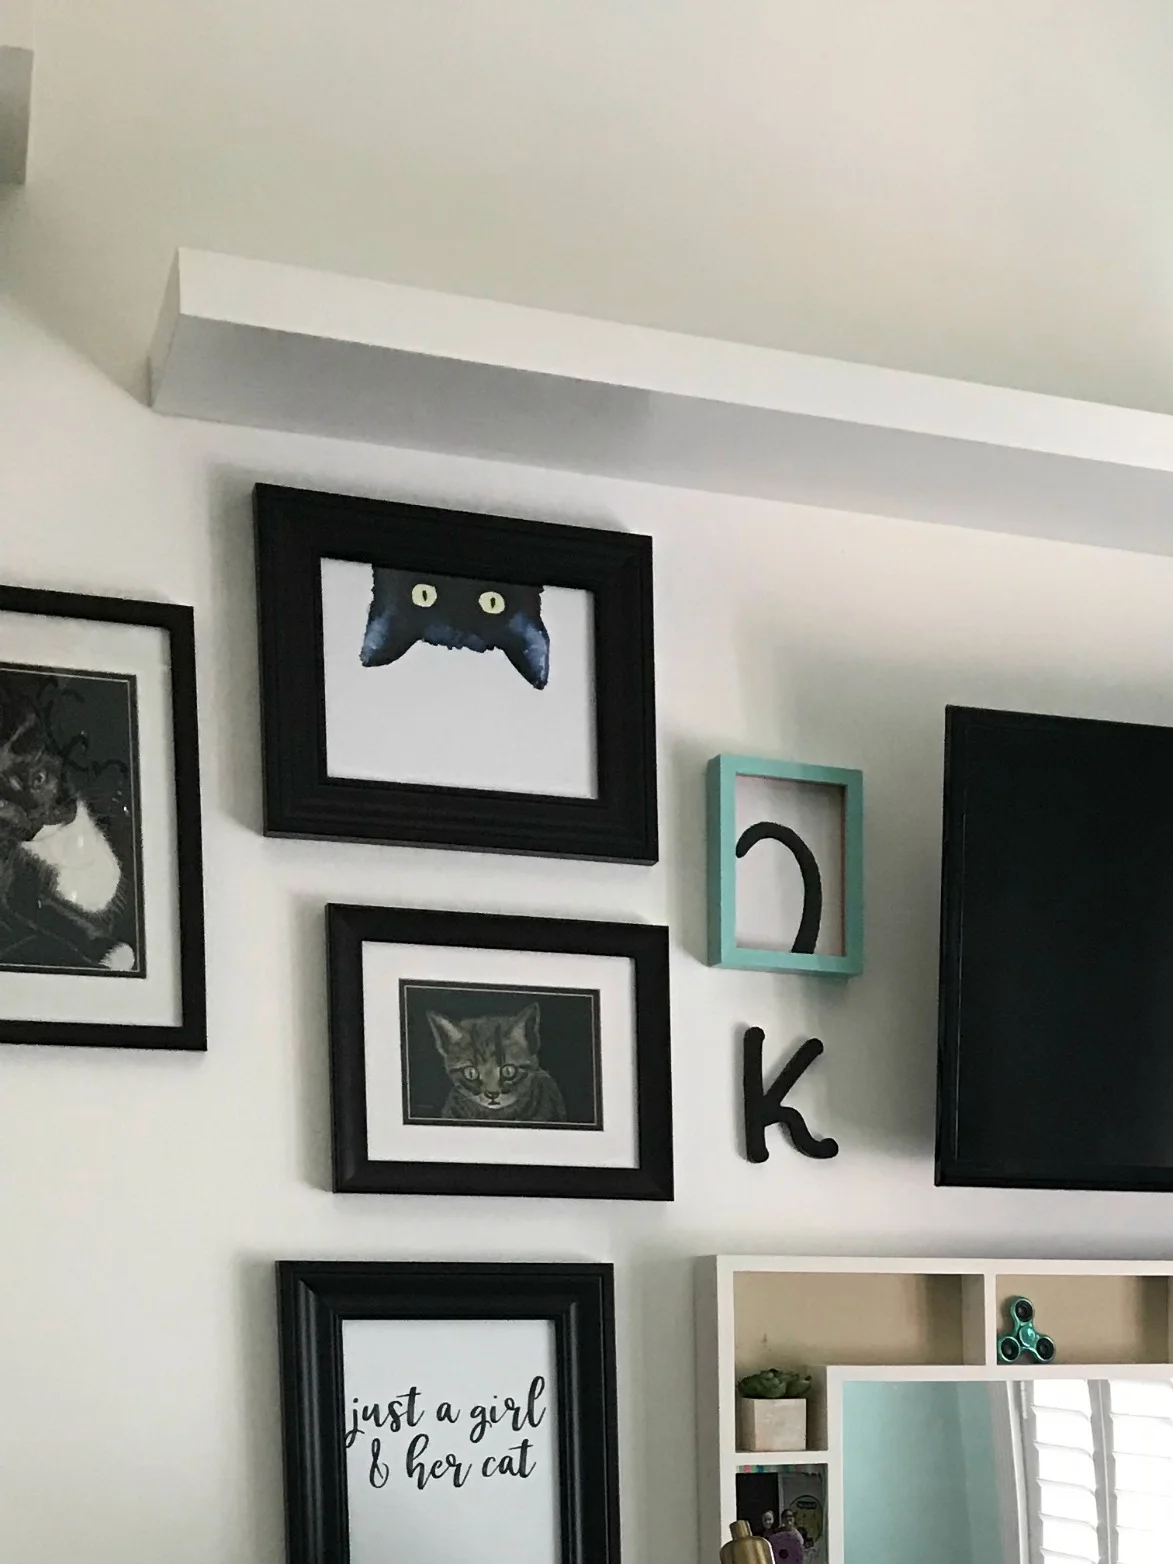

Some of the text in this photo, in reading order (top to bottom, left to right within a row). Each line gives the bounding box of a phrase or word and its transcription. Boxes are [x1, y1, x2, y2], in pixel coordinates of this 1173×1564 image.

[344, 1376, 547, 1449] just a girl
[369, 1433, 537, 1490] & her cat
